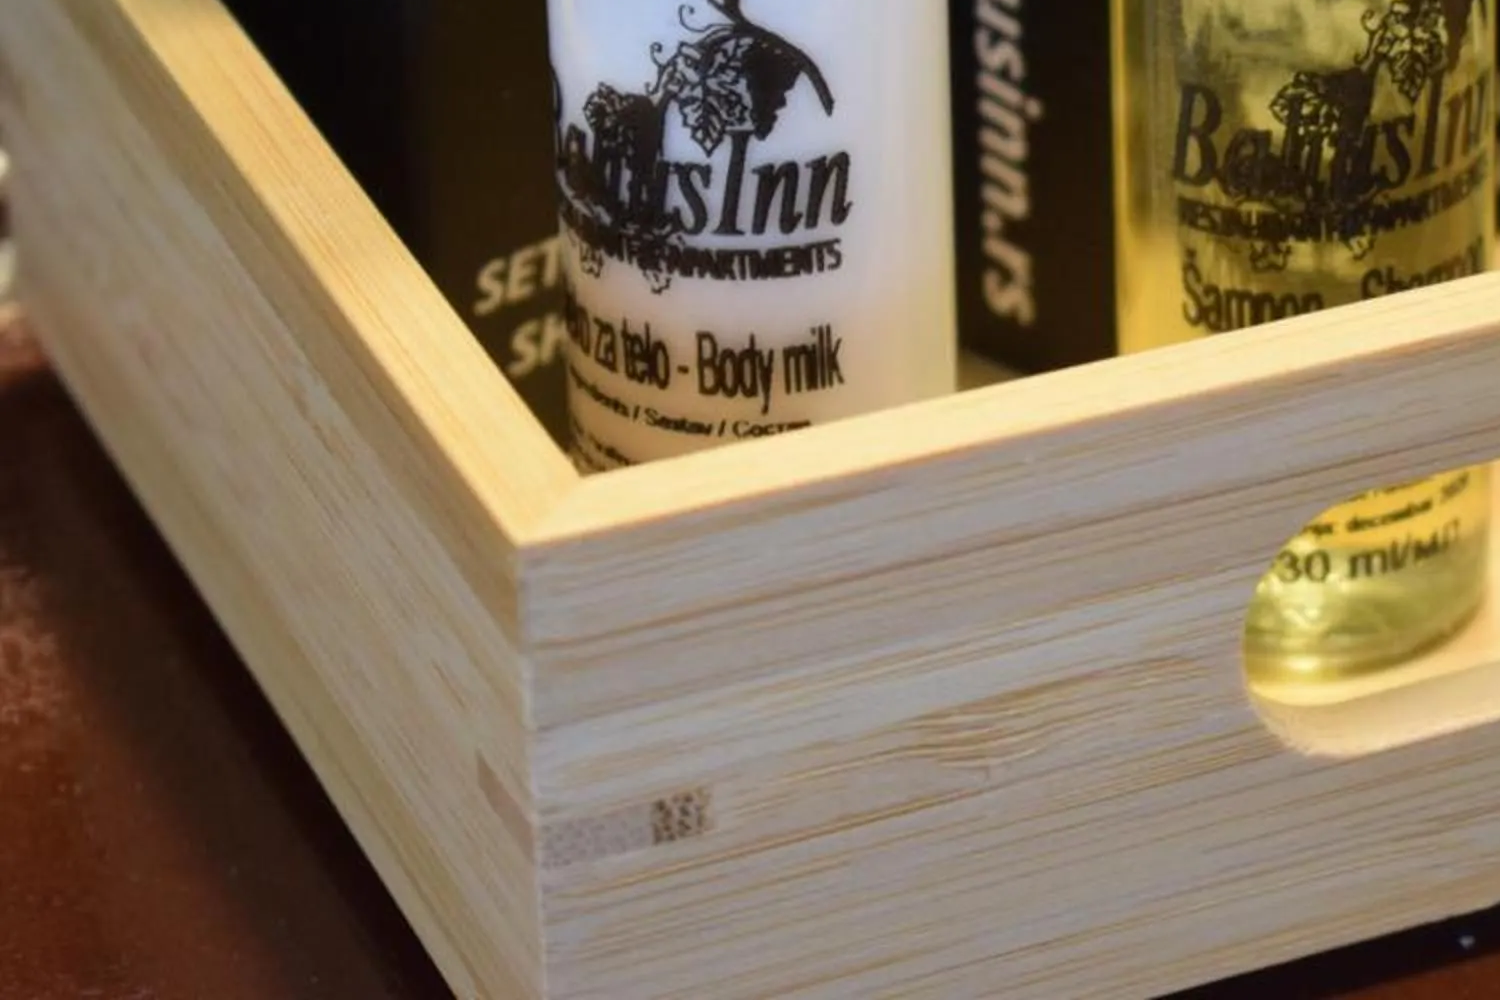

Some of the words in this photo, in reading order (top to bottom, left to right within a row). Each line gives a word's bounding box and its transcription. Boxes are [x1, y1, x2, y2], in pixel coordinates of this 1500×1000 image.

[556, 100, 853, 237] usInn
[696, 330, 775, 413] Body
[783, 323, 845, 392] milk
[1277, 549, 1331, 583] 30
